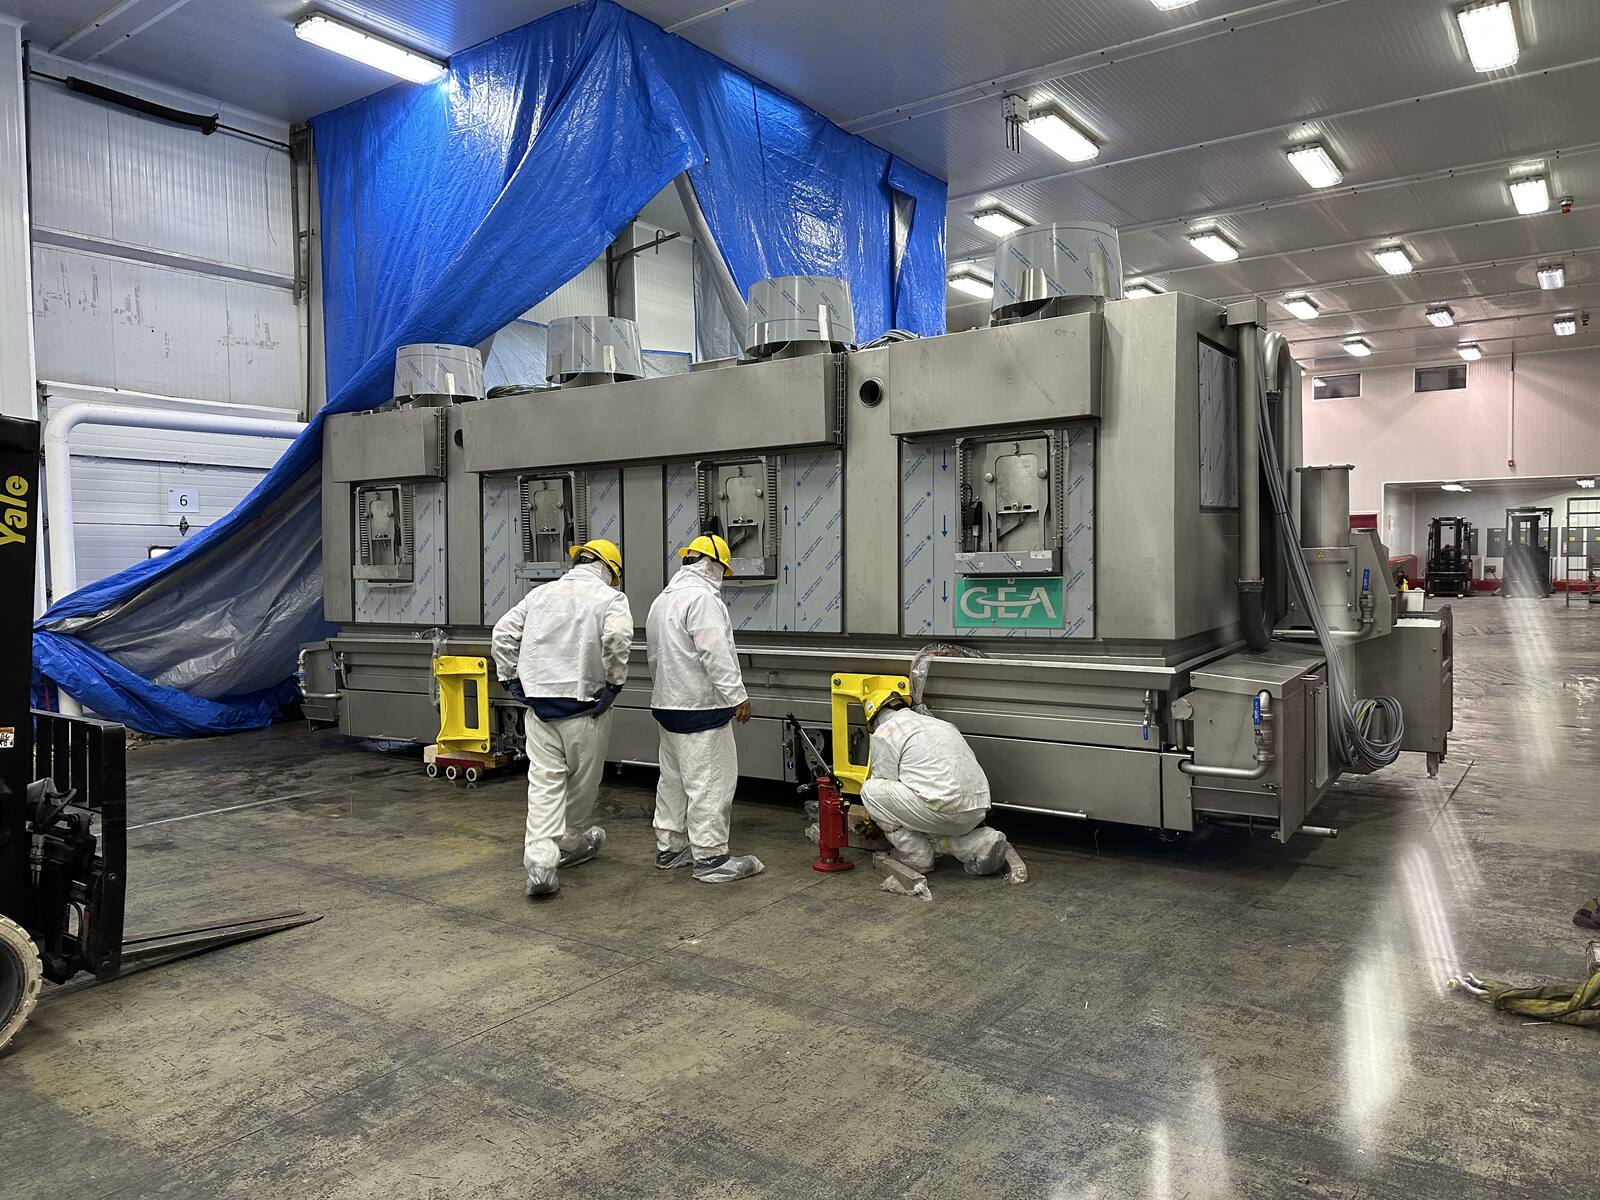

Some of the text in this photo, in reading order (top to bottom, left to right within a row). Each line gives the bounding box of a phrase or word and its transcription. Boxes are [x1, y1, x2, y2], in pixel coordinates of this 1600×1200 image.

[0, 475, 28, 545] Yale
[179, 494, 188, 506] 6
[960, 587, 1057, 618] GEA
